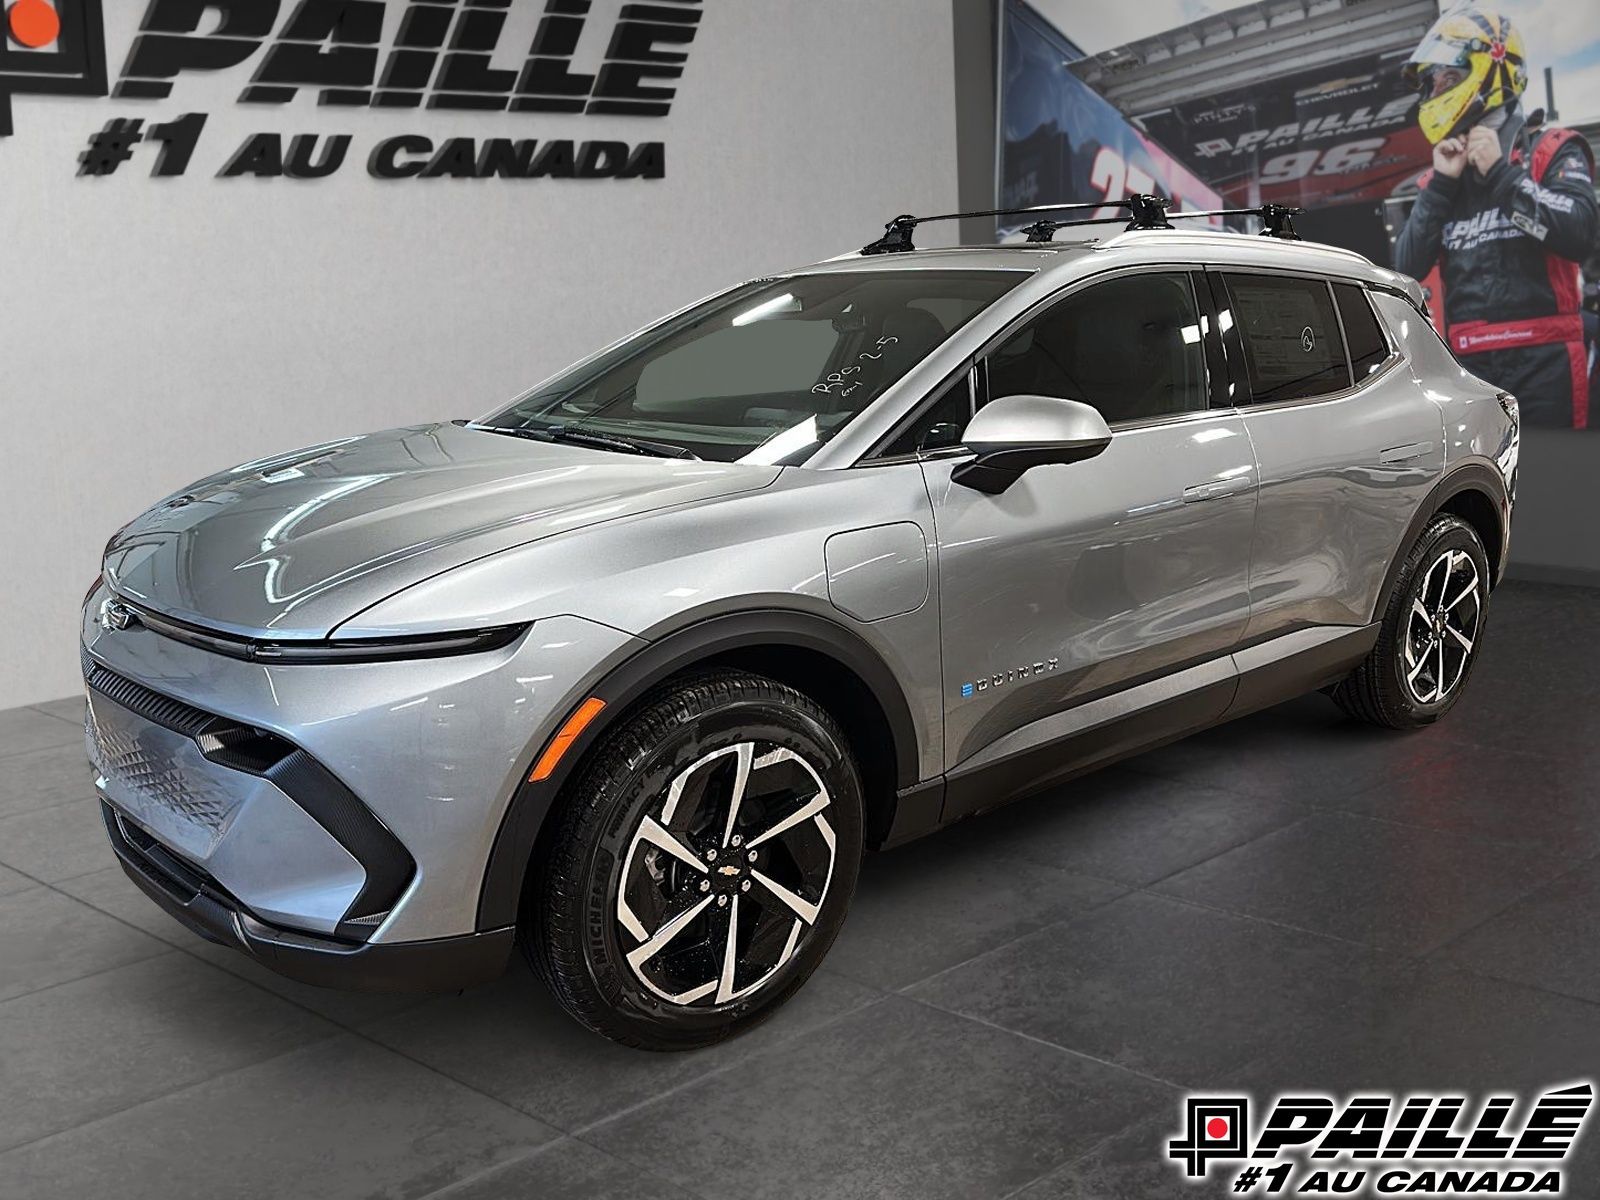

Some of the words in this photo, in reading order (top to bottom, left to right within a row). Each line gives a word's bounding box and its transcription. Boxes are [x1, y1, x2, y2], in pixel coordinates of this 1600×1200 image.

[75, 113, 209, 178] #1
[214, 132, 353, 179] AU
[366, 134, 666, 180] CANADA
[1260, 137, 1387, 185] 96
[1263, 137, 1295, 150] AU
[1302, 115, 1407, 142] CANADA
[590, 853, 611, 965] MICHE
